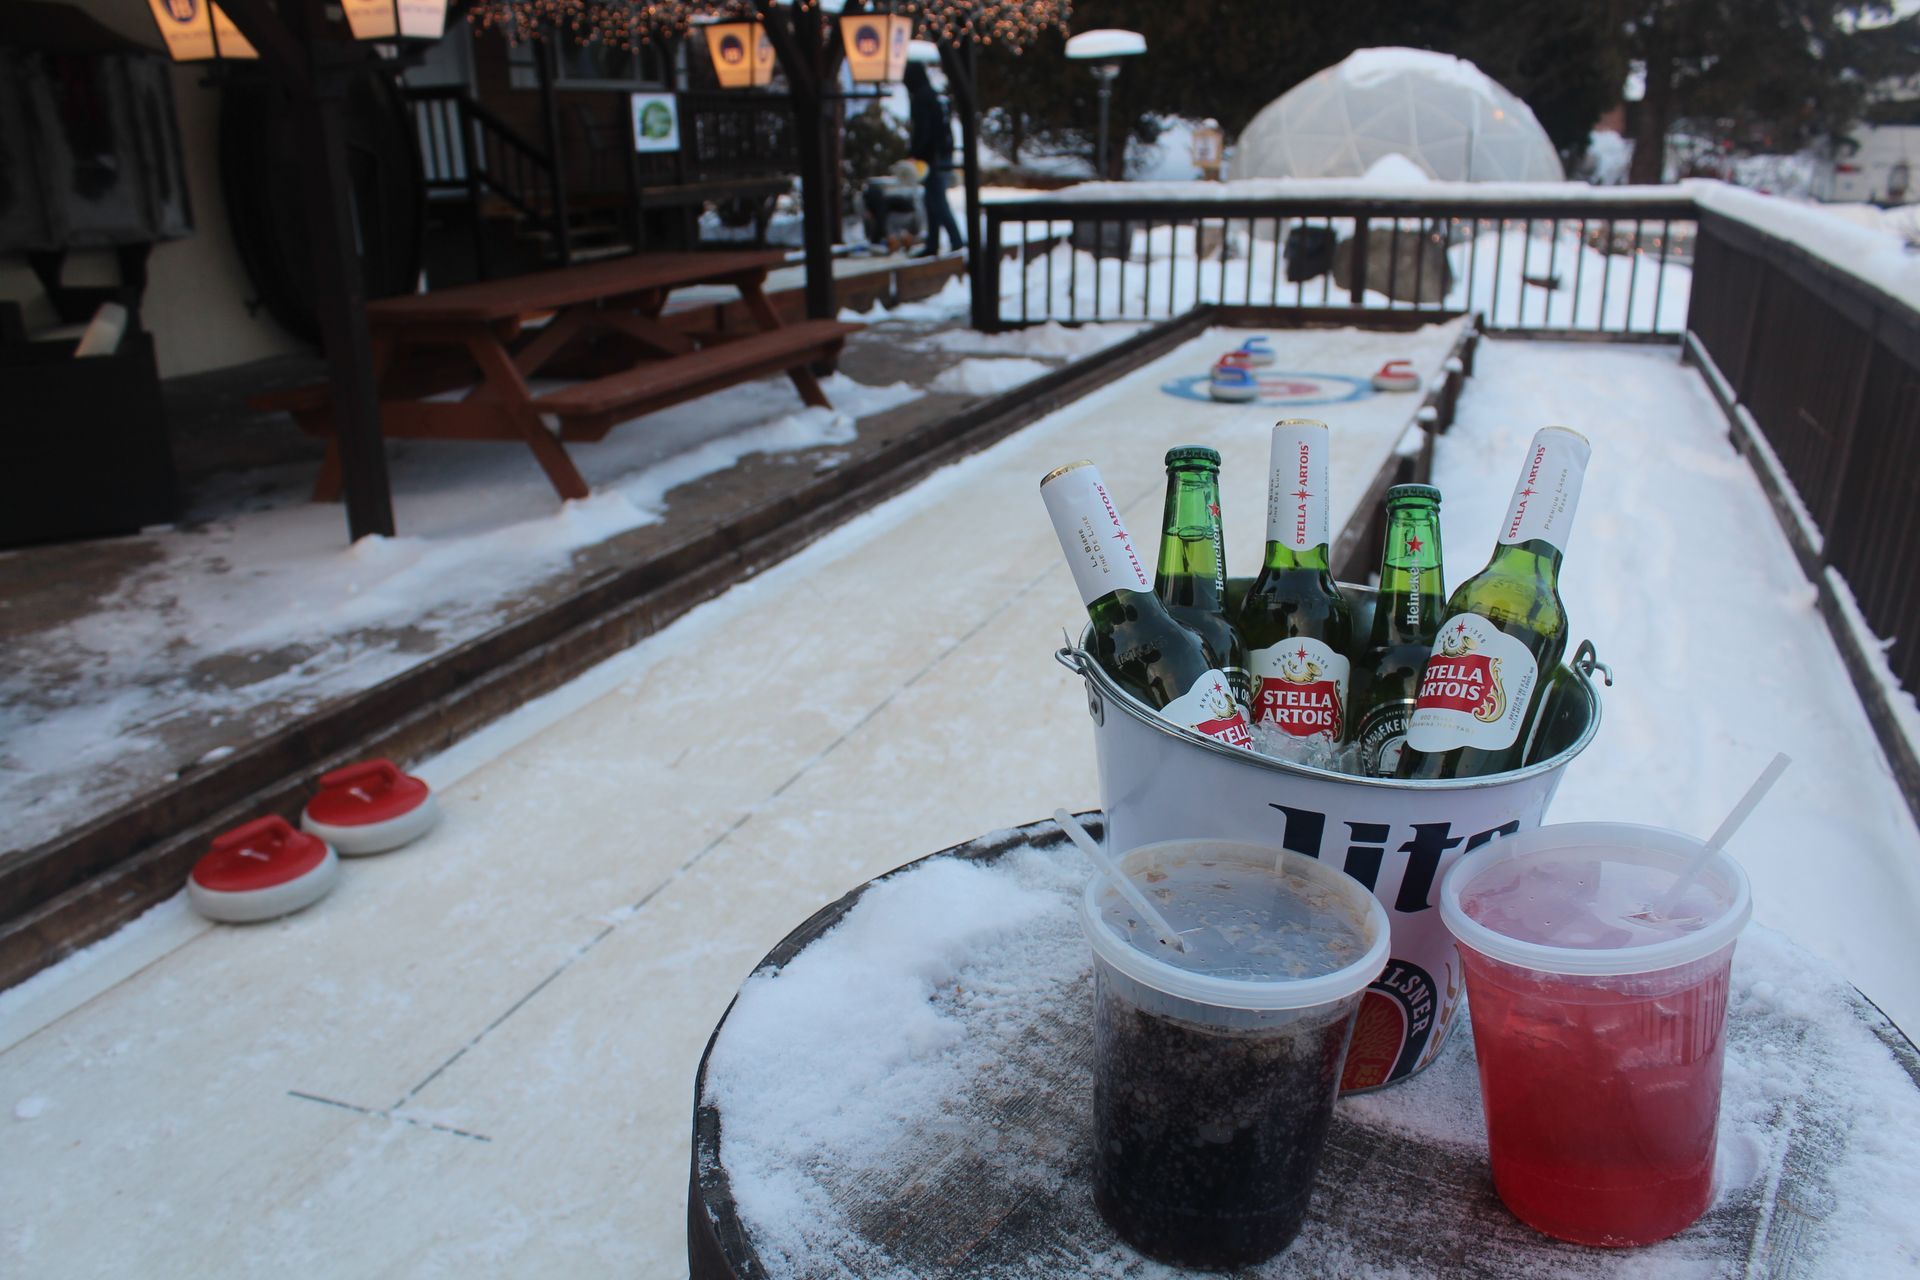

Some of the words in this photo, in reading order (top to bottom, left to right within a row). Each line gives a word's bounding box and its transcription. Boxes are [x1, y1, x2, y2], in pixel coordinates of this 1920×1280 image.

[1299, 445, 1309, 486] ARTOIS
[1097, 485, 1120, 526] ARTOIS
[1508, 500, 1527, 538] STELLA
[1528, 447, 1545, 485] ARTOIS
[1296, 504, 1307, 544] STELLA
[1125, 544, 1147, 585] STELLA
[1213, 524, 1224, 590] Heineken
[1407, 559, 1419, 625] Heineken
[1418, 682, 1481, 701] ARTOIS
[1424, 665, 1483, 684] STELLA
[1261, 708, 1332, 725] ARTOIS
[1263, 690, 1332, 708] STELLA
[1384, 965, 1431, 1037] LSNER
